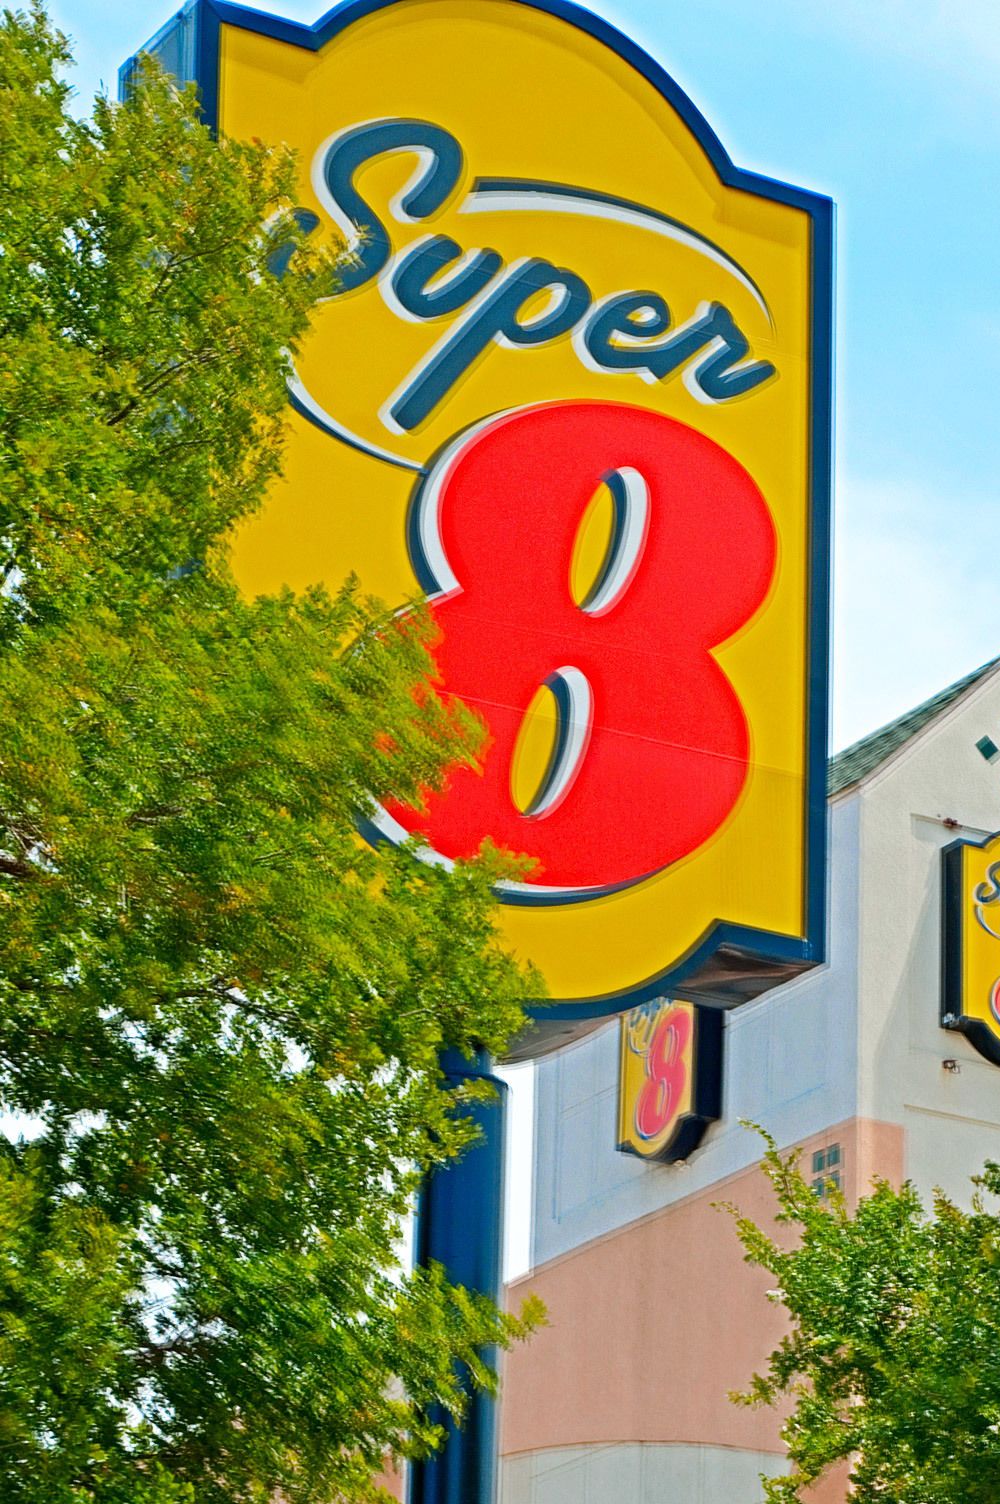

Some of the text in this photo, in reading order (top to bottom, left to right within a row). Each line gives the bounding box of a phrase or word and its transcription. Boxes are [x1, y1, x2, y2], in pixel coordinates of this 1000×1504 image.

[270, 117, 777, 436] Super
[350, 400, 778, 906] 8
[635, 1006, 692, 1140] 8
